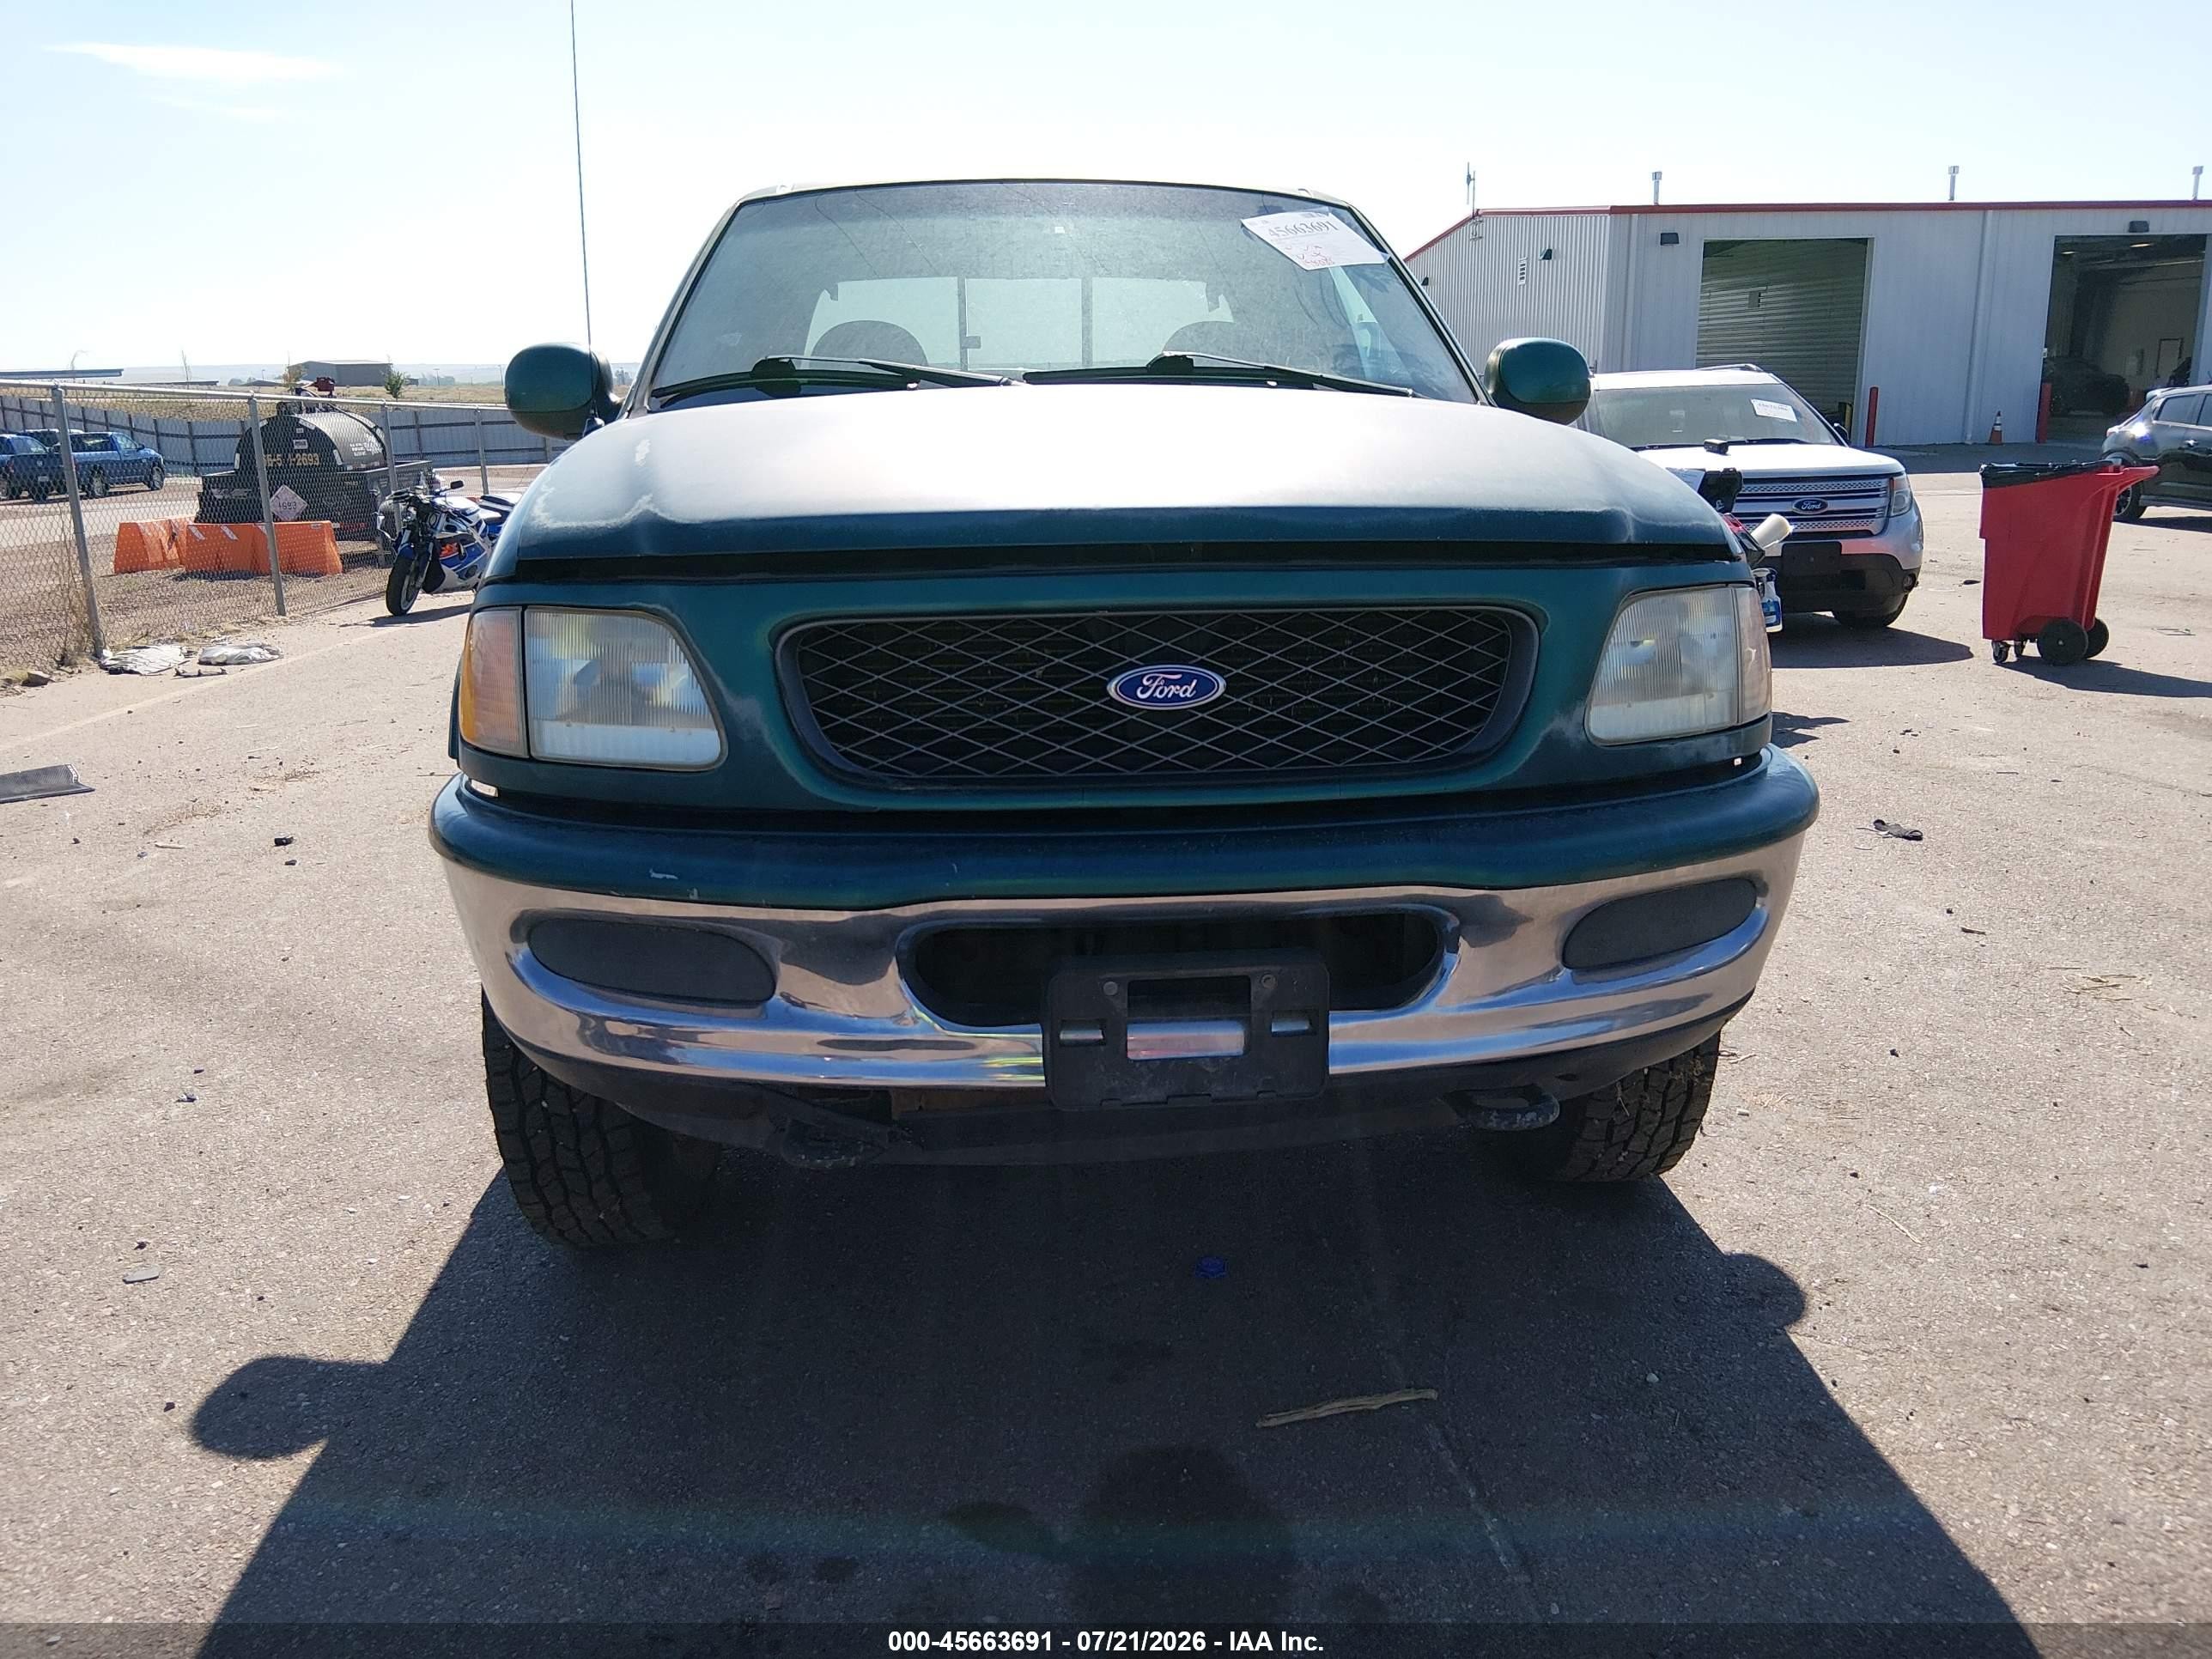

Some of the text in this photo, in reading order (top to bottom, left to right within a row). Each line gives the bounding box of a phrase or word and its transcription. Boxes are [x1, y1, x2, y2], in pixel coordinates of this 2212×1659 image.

[1268, 220, 1340, 237] 45663691
[1801, 500, 1822, 511] Ford
[1136, 672, 1198, 700] Ford
